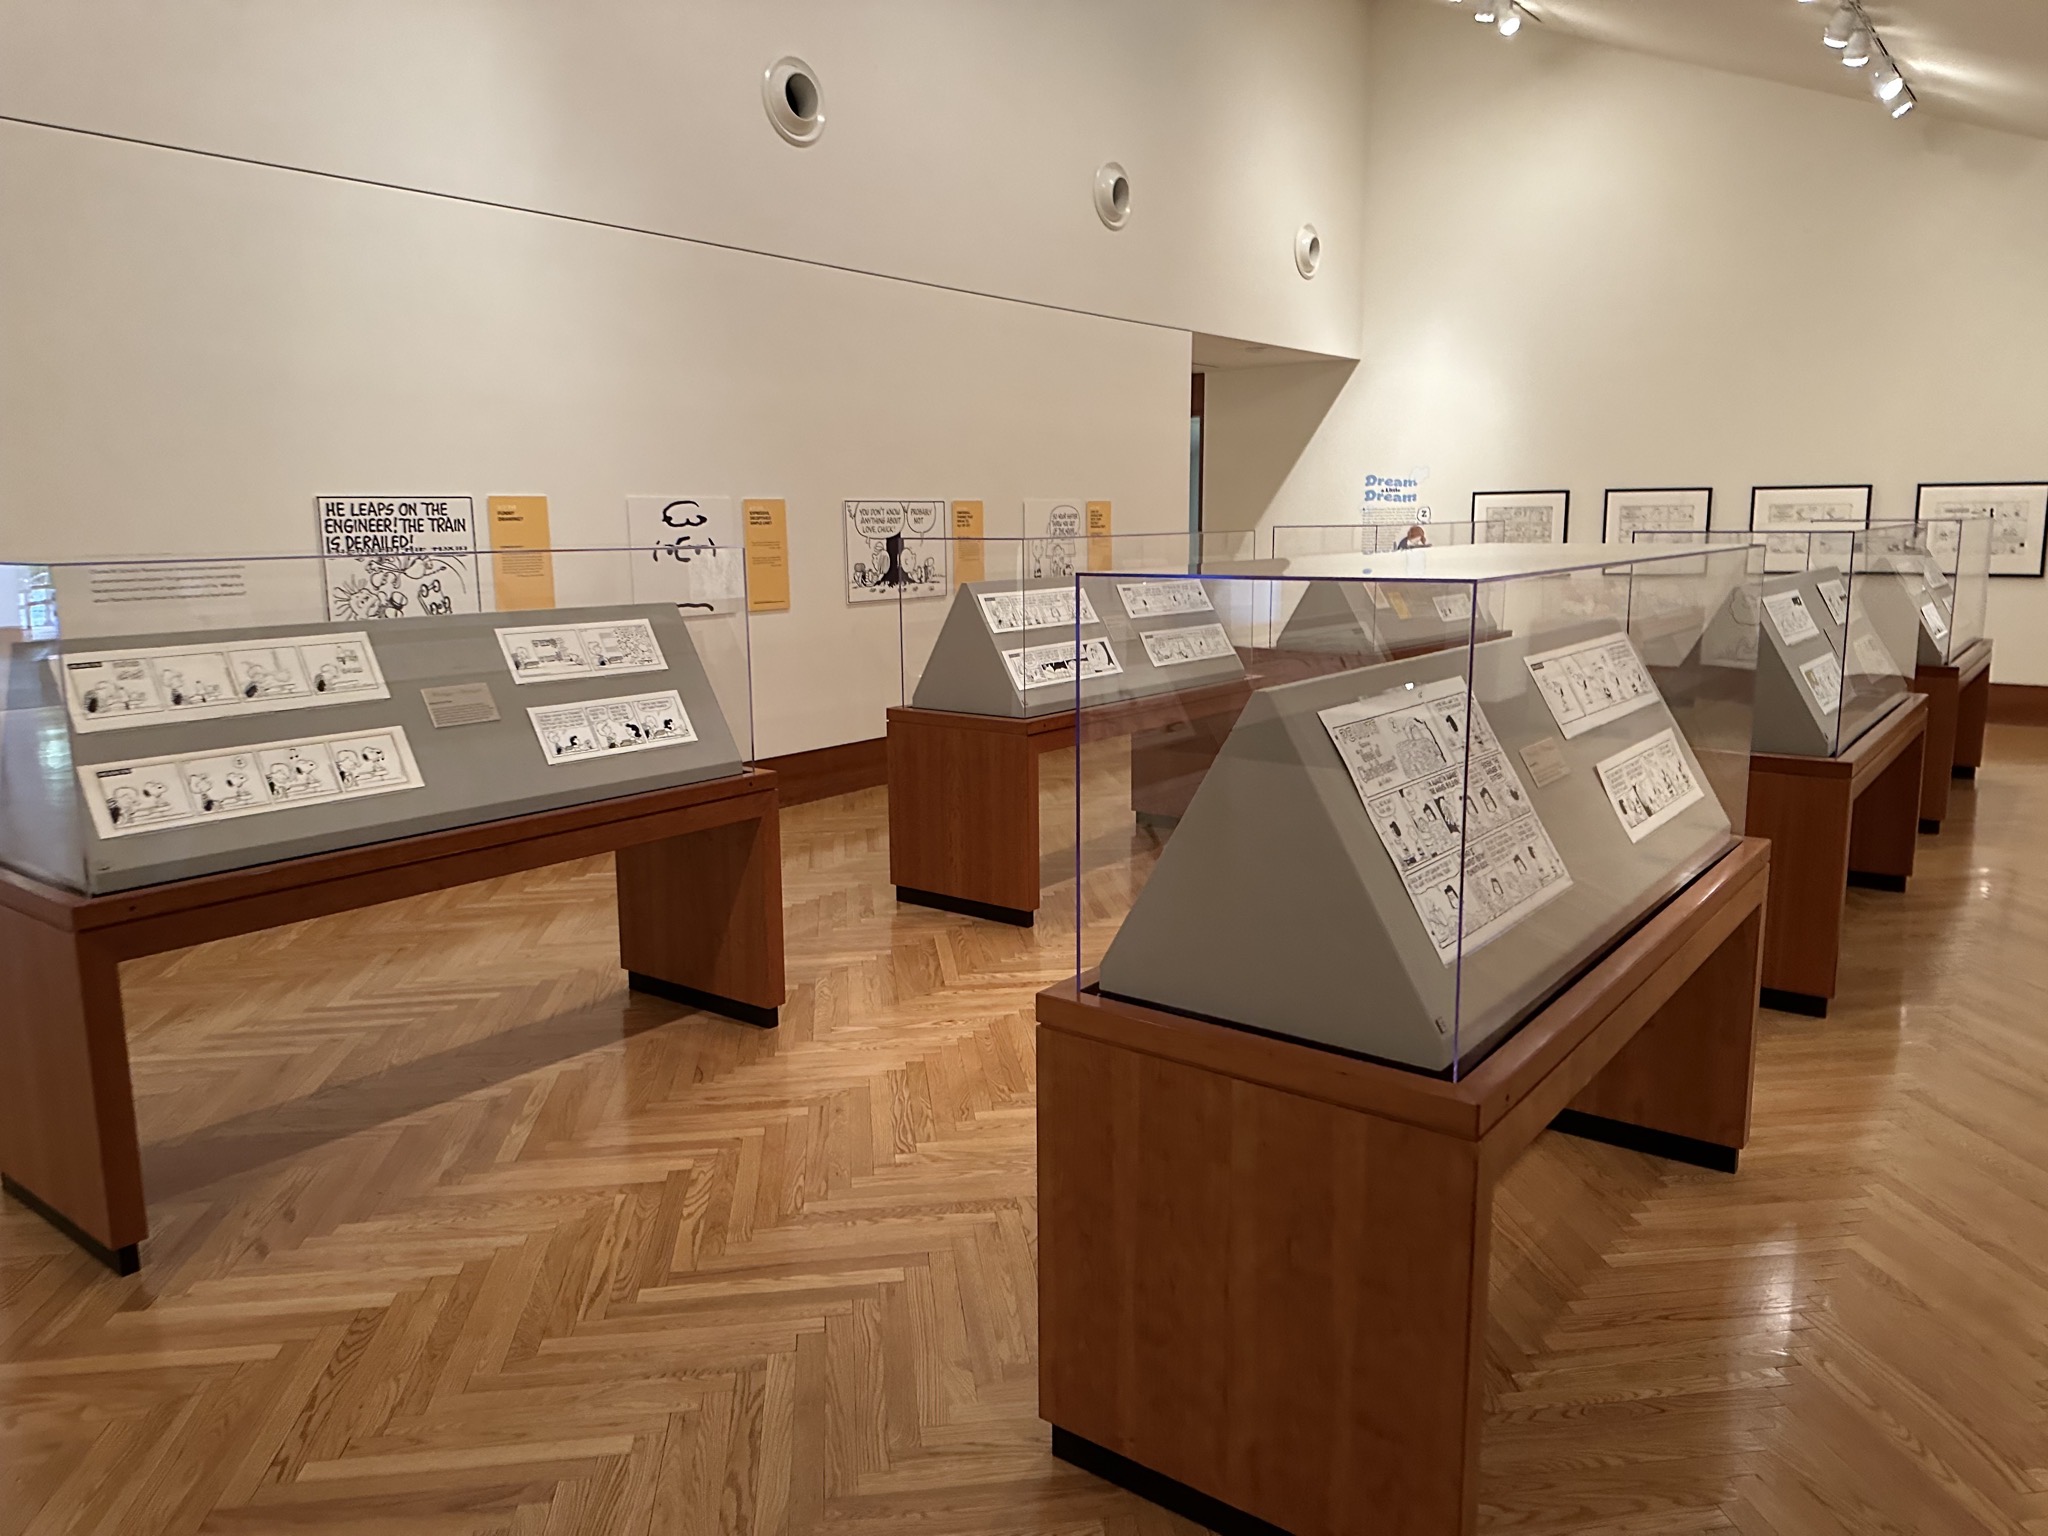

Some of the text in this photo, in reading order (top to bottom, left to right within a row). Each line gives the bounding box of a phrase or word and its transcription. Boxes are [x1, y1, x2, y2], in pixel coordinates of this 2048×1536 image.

[1365, 474, 1417, 487] Dream
[1364, 489, 1416, 502] Dream
[325, 501, 448, 517] HE LEAPS ON THE
[859, 507, 900, 516] YOU DON'T KNOW
[910, 508, 932, 516] PROBABLY
[324, 517, 466, 533] ENGINEER! THE TRAIN
[325, 534, 413, 551] IS DERAILED!
